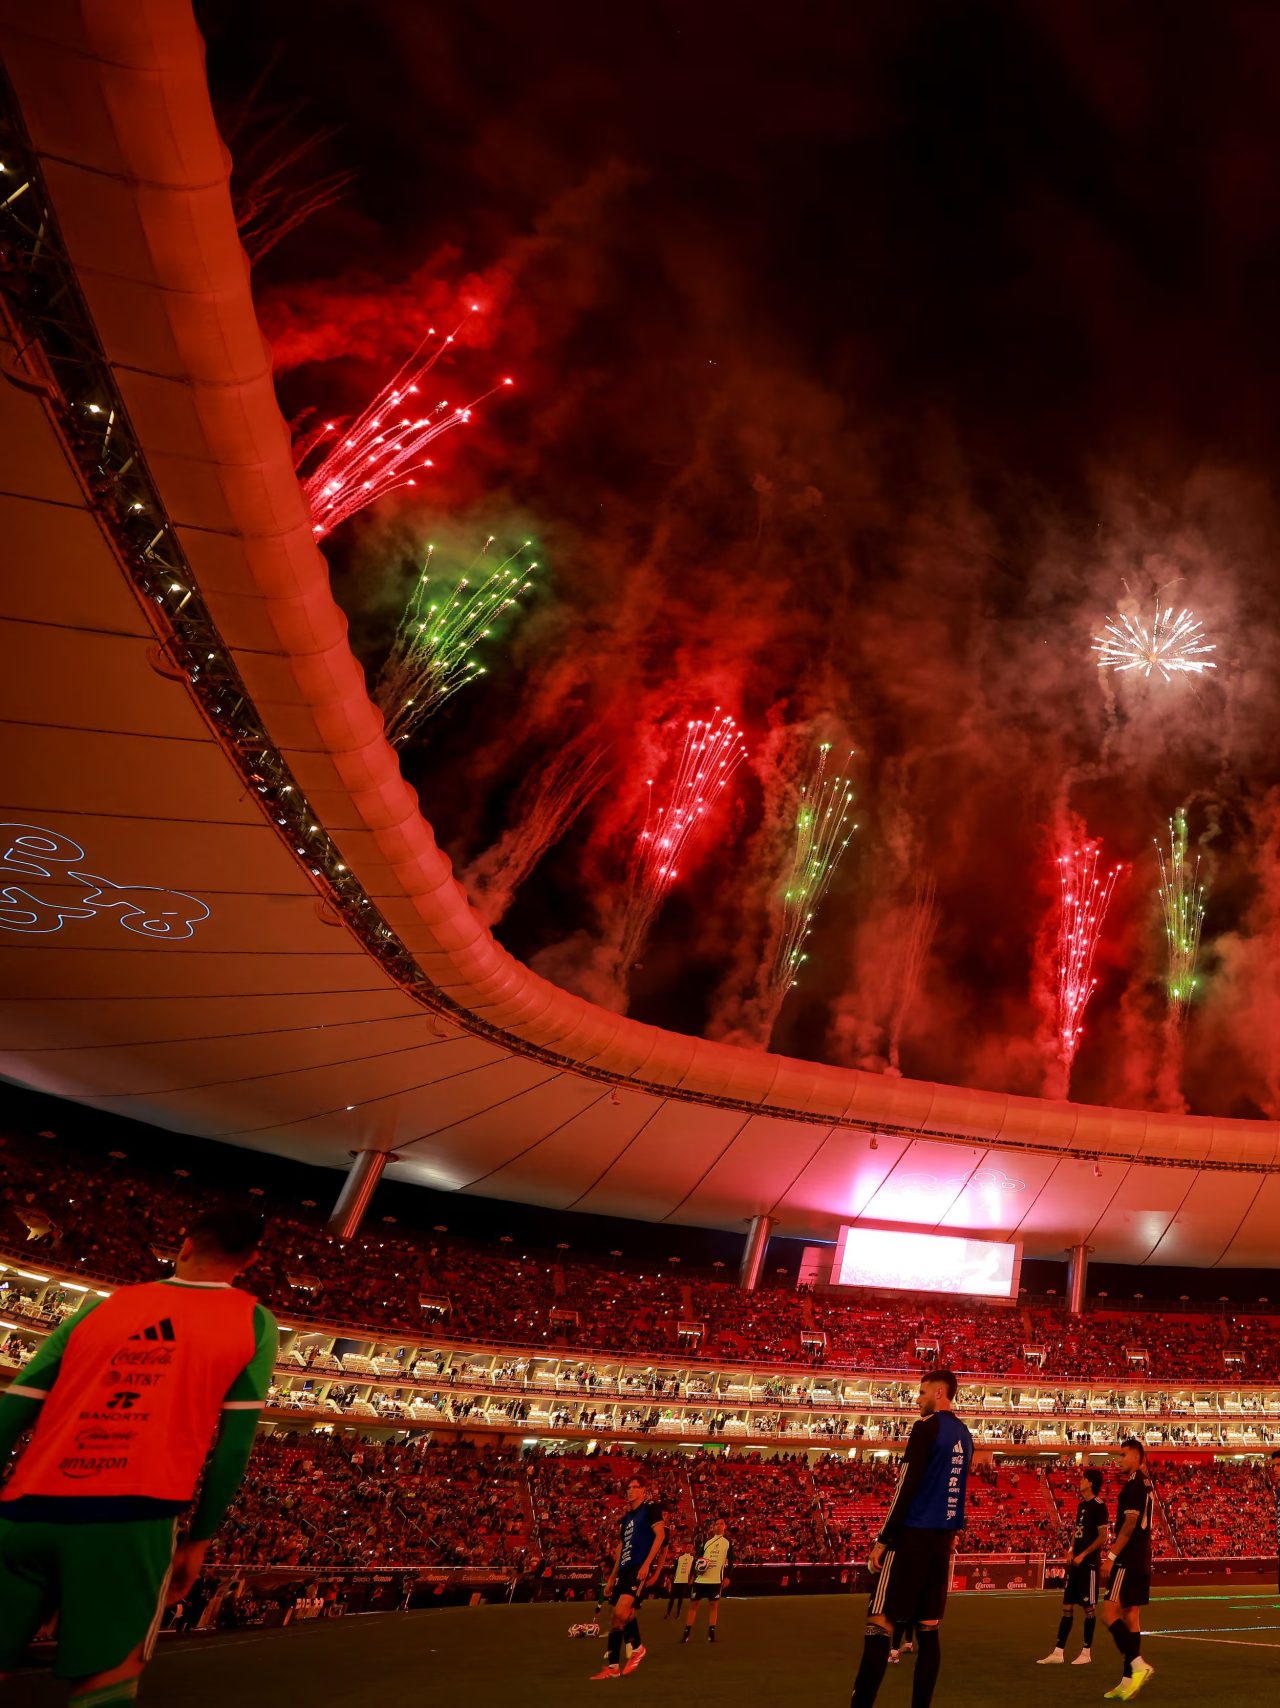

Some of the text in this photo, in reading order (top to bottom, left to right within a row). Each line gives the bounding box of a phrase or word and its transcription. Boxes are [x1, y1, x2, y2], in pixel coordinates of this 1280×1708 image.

[124, 1373, 163, 1386] AT&T
[80, 1411, 149, 1421] BANORTE
[58, 1457, 128, 1470] amazon
